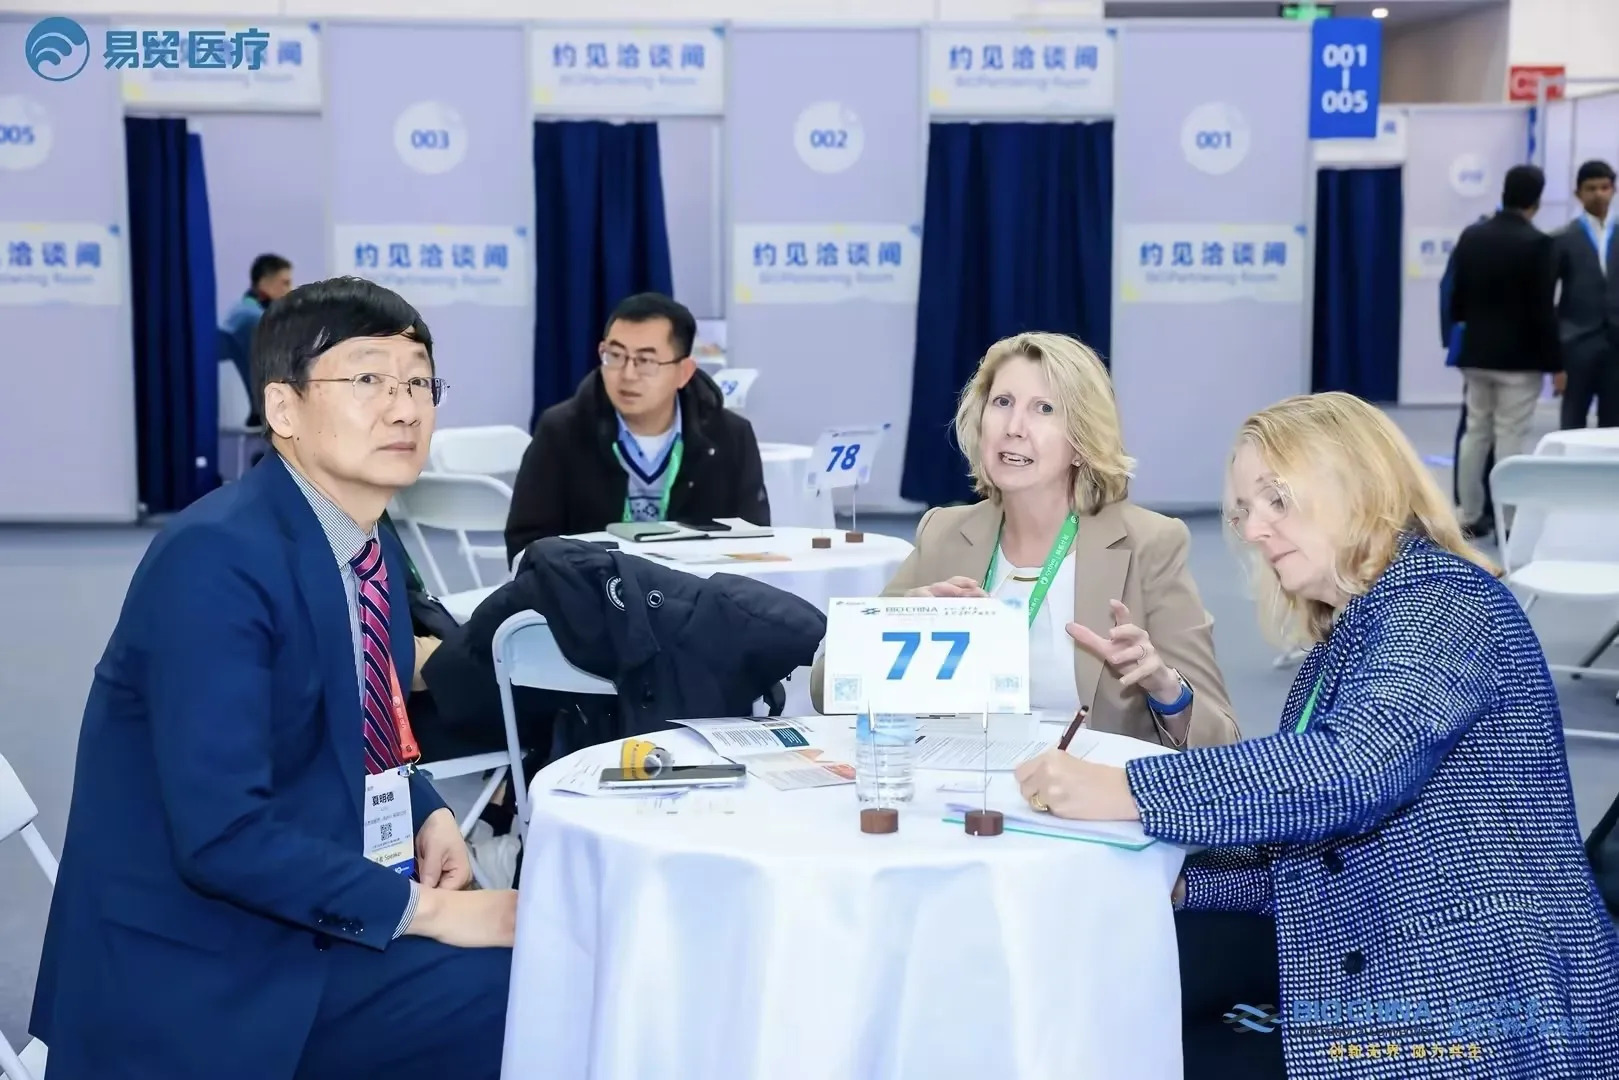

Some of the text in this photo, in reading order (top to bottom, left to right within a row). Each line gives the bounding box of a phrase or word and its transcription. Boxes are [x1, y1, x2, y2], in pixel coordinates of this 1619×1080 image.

[553, 43, 705, 69] 约见洽谈间
[949, 45, 1098, 70] 约见洽谈间
[1322, 44, 1367, 68] 001
[1321, 89, 1368, 113] 005
[411, 129, 449, 149] 003
[810, 129, 848, 149] 002
[1196, 131, 1232, 149] 001
[0, 241, 101, 268] 洽谈间
[355, 243, 508, 268] 约见洽谈间
[753, 242, 902, 266] 约见洽谈间
[1139, 242, 1286, 266] 约见洽谈间
[826, 444, 860, 472] 78
[882, 631, 970, 680] 77
